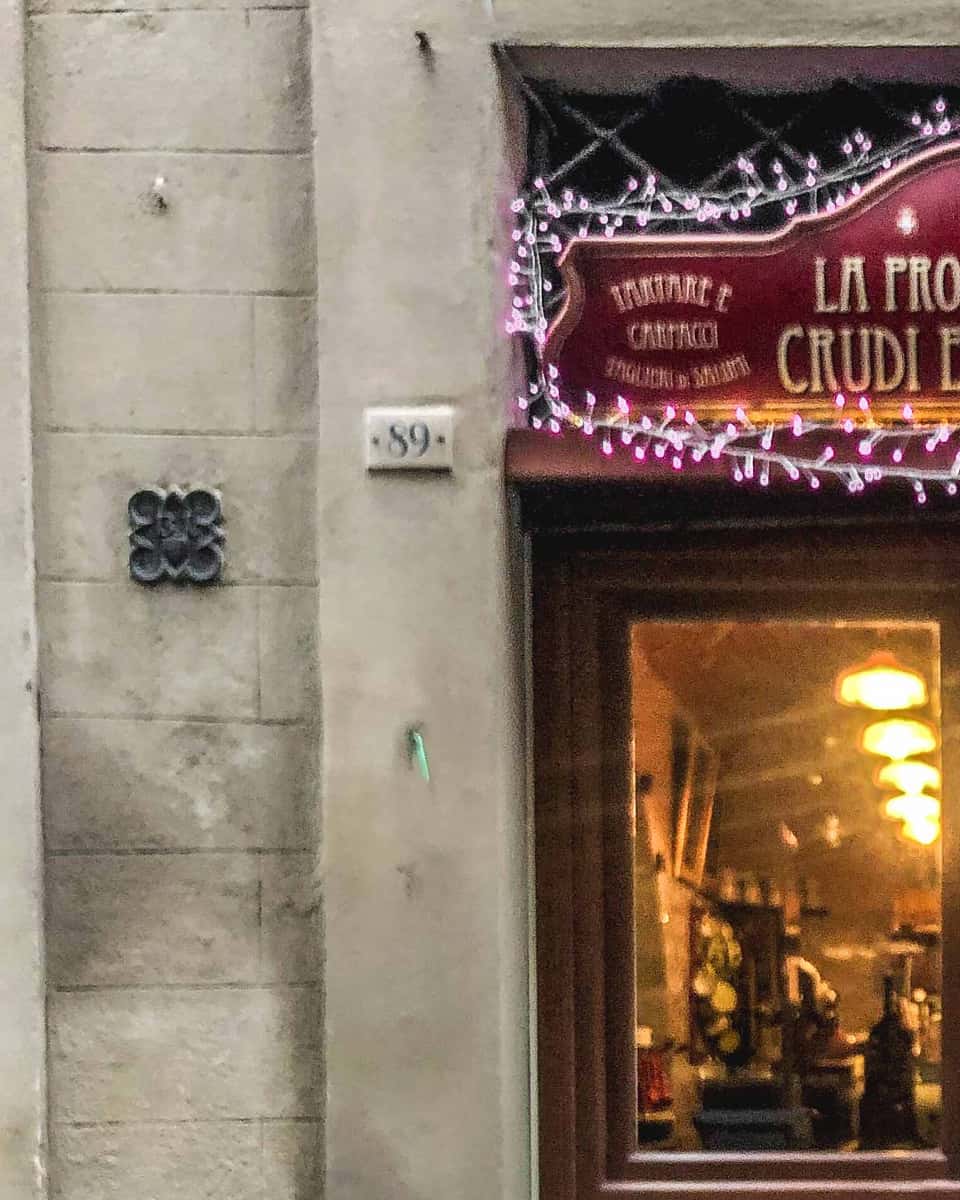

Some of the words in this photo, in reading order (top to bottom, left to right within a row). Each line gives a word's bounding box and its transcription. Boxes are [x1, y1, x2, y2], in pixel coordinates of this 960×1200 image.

[813, 254, 870, 313] LA
[776, 324, 922, 394] CRUDI
[388, 420, 431, 459] 89
